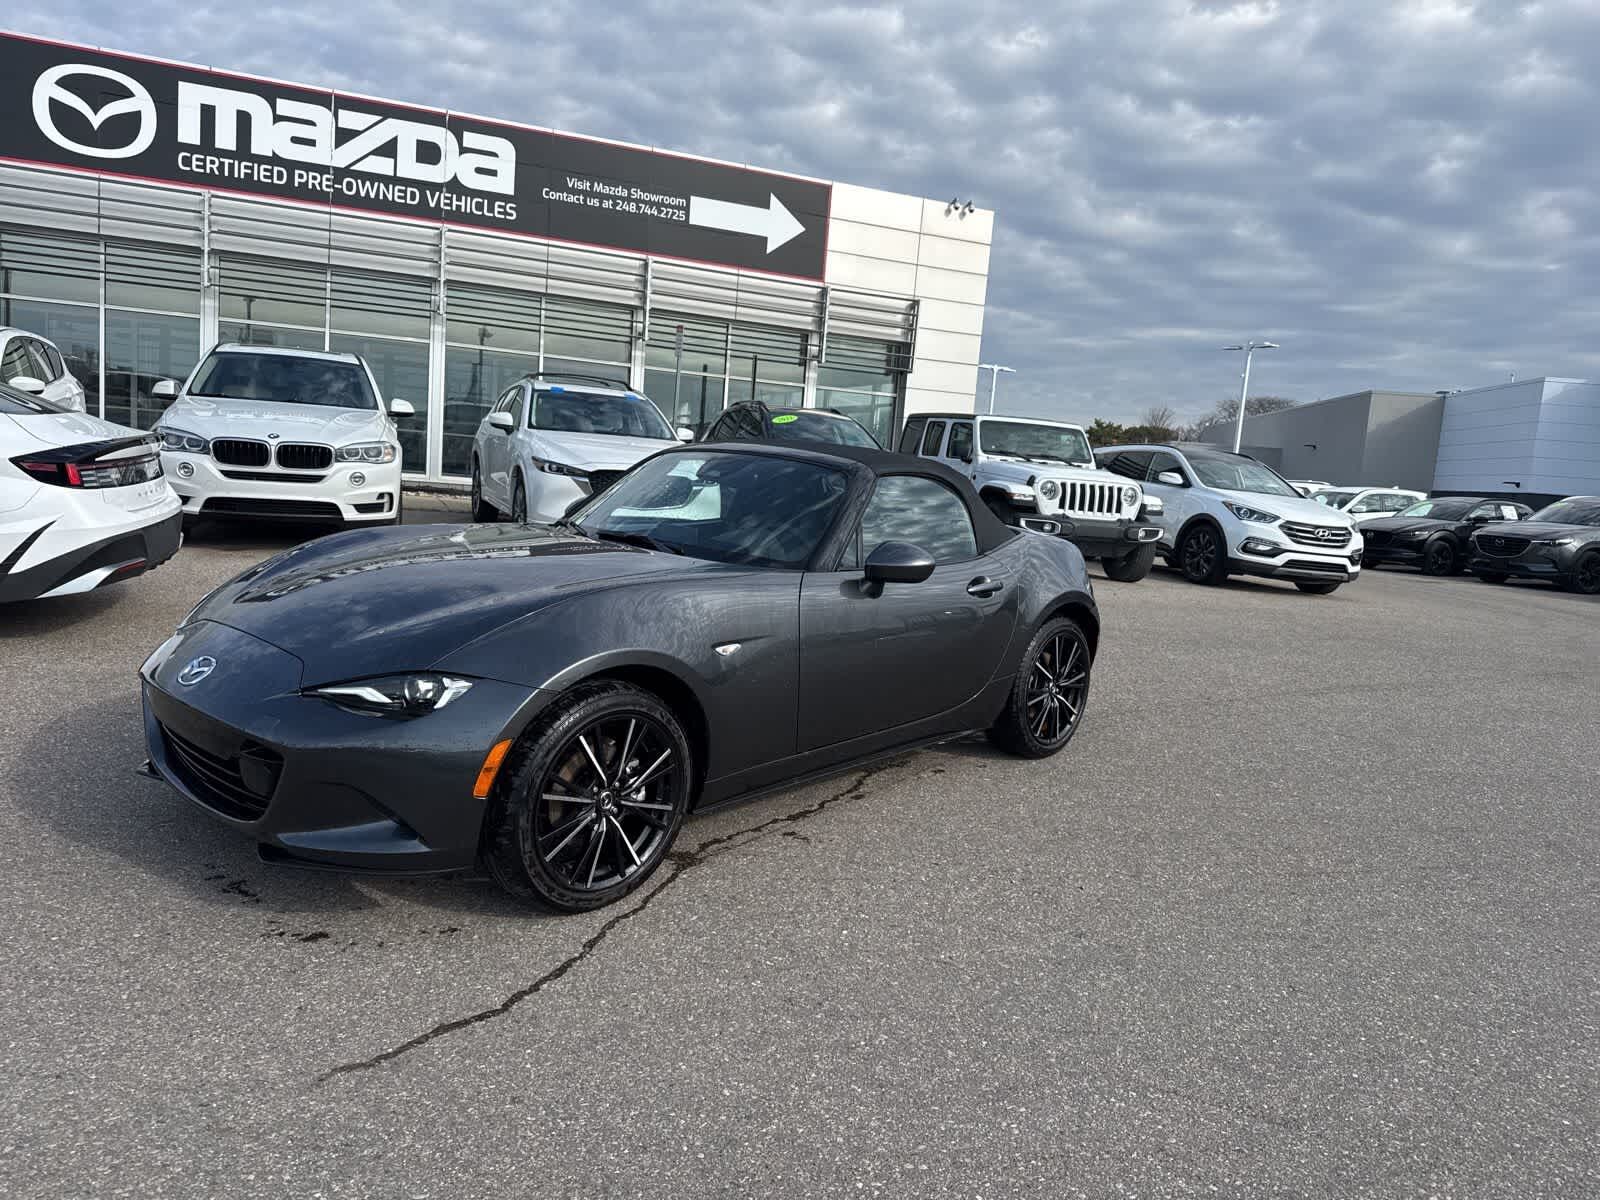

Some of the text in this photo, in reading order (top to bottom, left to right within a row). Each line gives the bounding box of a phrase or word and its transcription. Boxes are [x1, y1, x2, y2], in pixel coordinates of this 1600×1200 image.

[178, 152, 517, 220] CERTIFIED PRE-OWNED VEHICLES
[566, 177, 686, 207] Visit Mazda Showroom
[542, 187, 686, 221] Contact us at 248.744.2725
